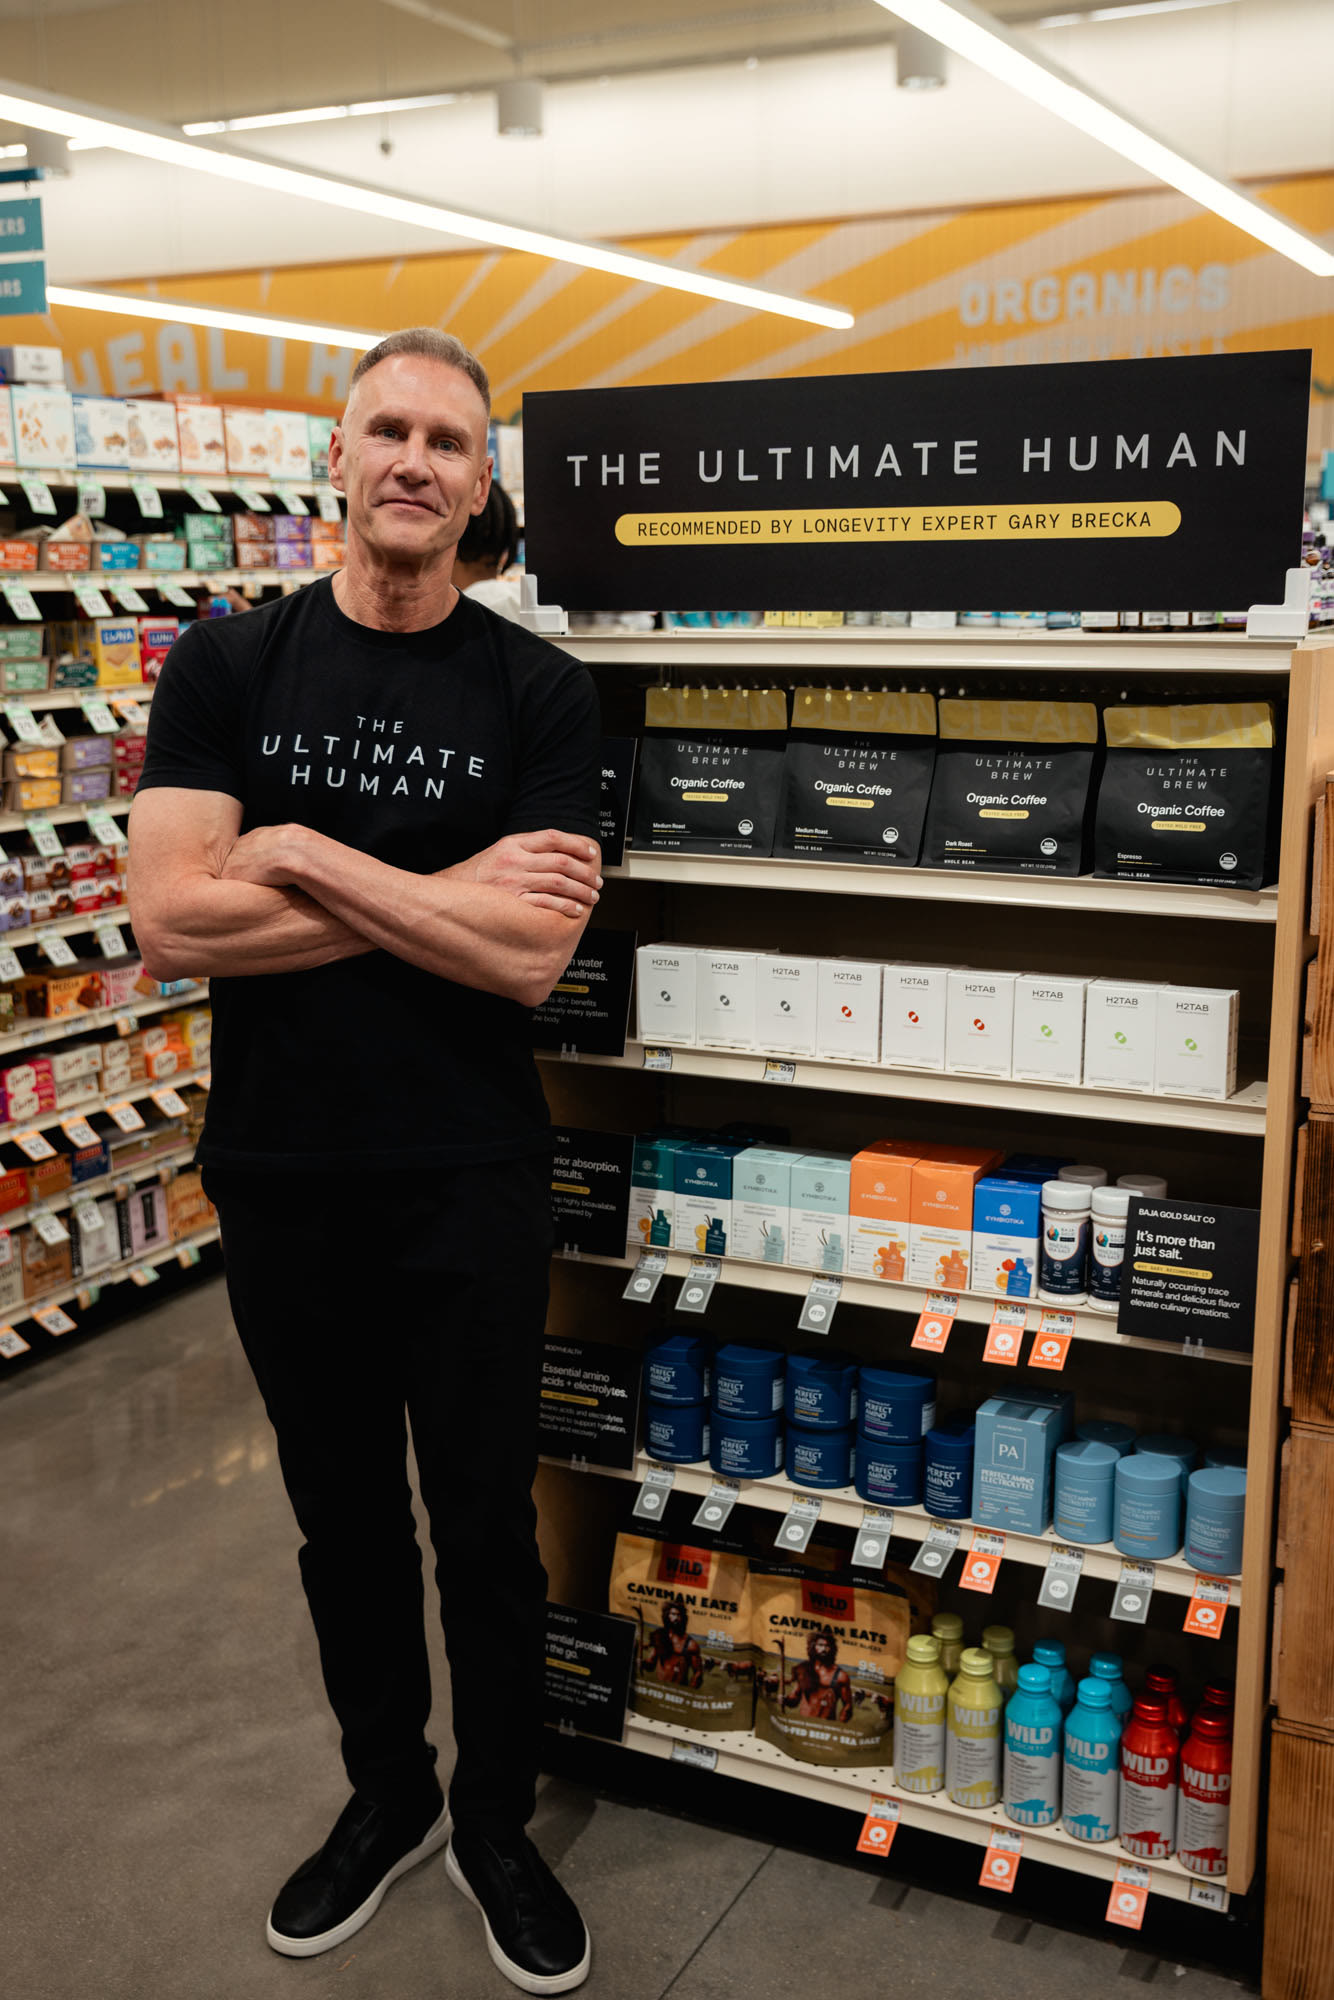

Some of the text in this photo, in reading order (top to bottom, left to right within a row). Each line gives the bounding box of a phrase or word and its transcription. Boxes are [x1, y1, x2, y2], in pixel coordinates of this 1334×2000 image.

[959, 264, 1232, 327] ORGANICS
[567, 430, 1248, 487] THE ULTIMATE HUMAN
[637, 510, 1152, 537] RECOMMENDED BY LONGEVITY EXPERT GARY BRECKA
[356, 715, 404, 733] THE
[262, 734, 485, 778] ULTIMATE
[677, 745, 749, 755] ULTIMATE
[824, 748, 897, 760] ULTIMATE
[692, 757, 730, 765] BREW
[839, 761, 878, 770] BREW
[976, 758, 1053, 769] ULTIMATE
[991, 772, 1032, 780] BREW
[1146, 768, 1228, 777] ULTIMATE
[291, 765, 445, 799] HUMAN
[671, 777, 745, 789] Organic Coffee
[815, 780, 892, 795] Organic Coffee
[1163, 781, 1208, 790] BREW
[967, 792, 1048, 806] Organic Coffee
[1137, 803, 1226, 817] Organic Coffee
[1117, 852, 1143, 862] Espresso
[577, 959, 604, 968] water
[652, 959, 680, 967] H2TAB
[711, 963, 739, 971] H2TAB
[566, 969, 608, 981] wellness.
[771, 968, 800, 976] H2TAB
[833, 972, 862, 981] H2TAB
[900, 977, 929, 986] H2TAB
[965, 984, 996, 994] H2TAB
[1032, 990, 1064, 999] H2TAB
[1106, 996, 1139, 1006] H2TAB
[1176, 1002, 1209, 1013] H2TAB
[572, 1158, 621, 1173] absorption.
[553, 1168, 585, 1180] results.
[1138, 1208, 1215, 1224] BAJA GOLD SALT CO
[1136, 1229, 1215, 1250] It’s more than
[1133, 1243, 1183, 1260] just salt.
[1132, 1276, 1229, 1296] Naturally occurring trace
[1131, 1288, 1240, 1309] minerals and delicious flavor
[1130, 1299, 1231, 1319] elevate culinary creations.
[543, 1362, 610, 1383] Essential amino
[541, 1376, 565, 1387] acids
[574, 1380, 628, 1398] electrolytes.
[999, 1443, 1019, 1460] PA
[927, 1466, 962, 1480] PERFECT
[981, 1468, 1034, 1485] PERFECT AMINO
[927, 1475, 955, 1488] AMINO
[981, 1475, 1034, 1491] ELECTROLYTES
[667, 1558, 703, 1576] WILD
[627, 1582, 738, 1613] CAVEMAN EATS
[810, 1592, 848, 1611] WILD
[769, 1614, 888, 1645] CAVEMAN EATS
[575, 1639, 608, 1655] protein.
[692, 1701, 710, 1710] SEA
[711, 1701, 734, 1711] SALT
[900, 1690, 944, 1713] WILD
[954, 1704, 999, 1727] WILD
[1007, 1718, 1053, 1745] WILD
[840, 1735, 858, 1746] SEA
[1065, 1733, 1109, 1760] WILD
[1122, 1747, 1169, 1776] WILD
[1127, 1768, 1160, 1783] SOCIETY
[1182, 1761, 1231, 1792] WILD
[1188, 1785, 1222, 1798] SOCIETY
